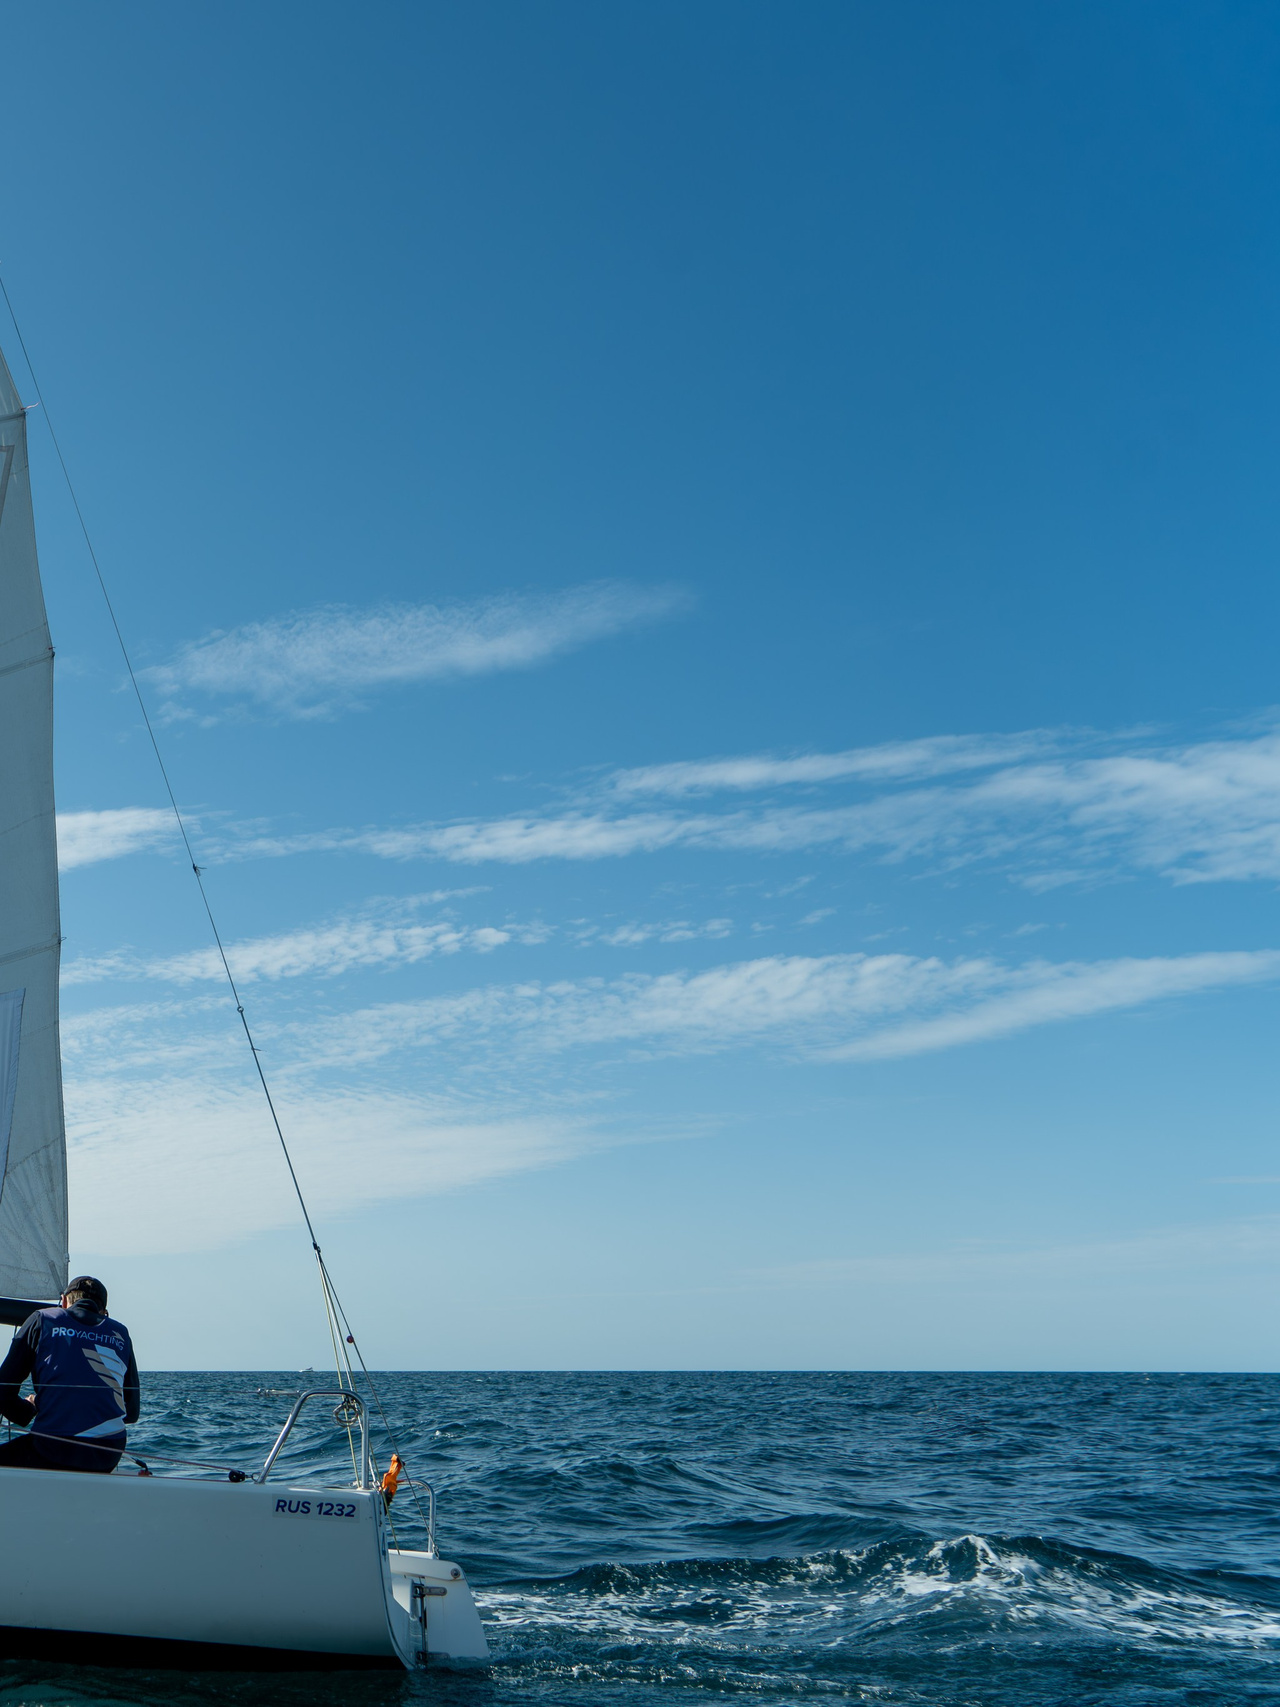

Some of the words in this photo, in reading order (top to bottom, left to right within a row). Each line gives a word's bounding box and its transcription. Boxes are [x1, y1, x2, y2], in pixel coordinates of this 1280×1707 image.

[51, 1326, 125, 1351] PROYACHTING
[274, 1498, 312, 1515] RUS
[316, 1502, 357, 1518] 1232
